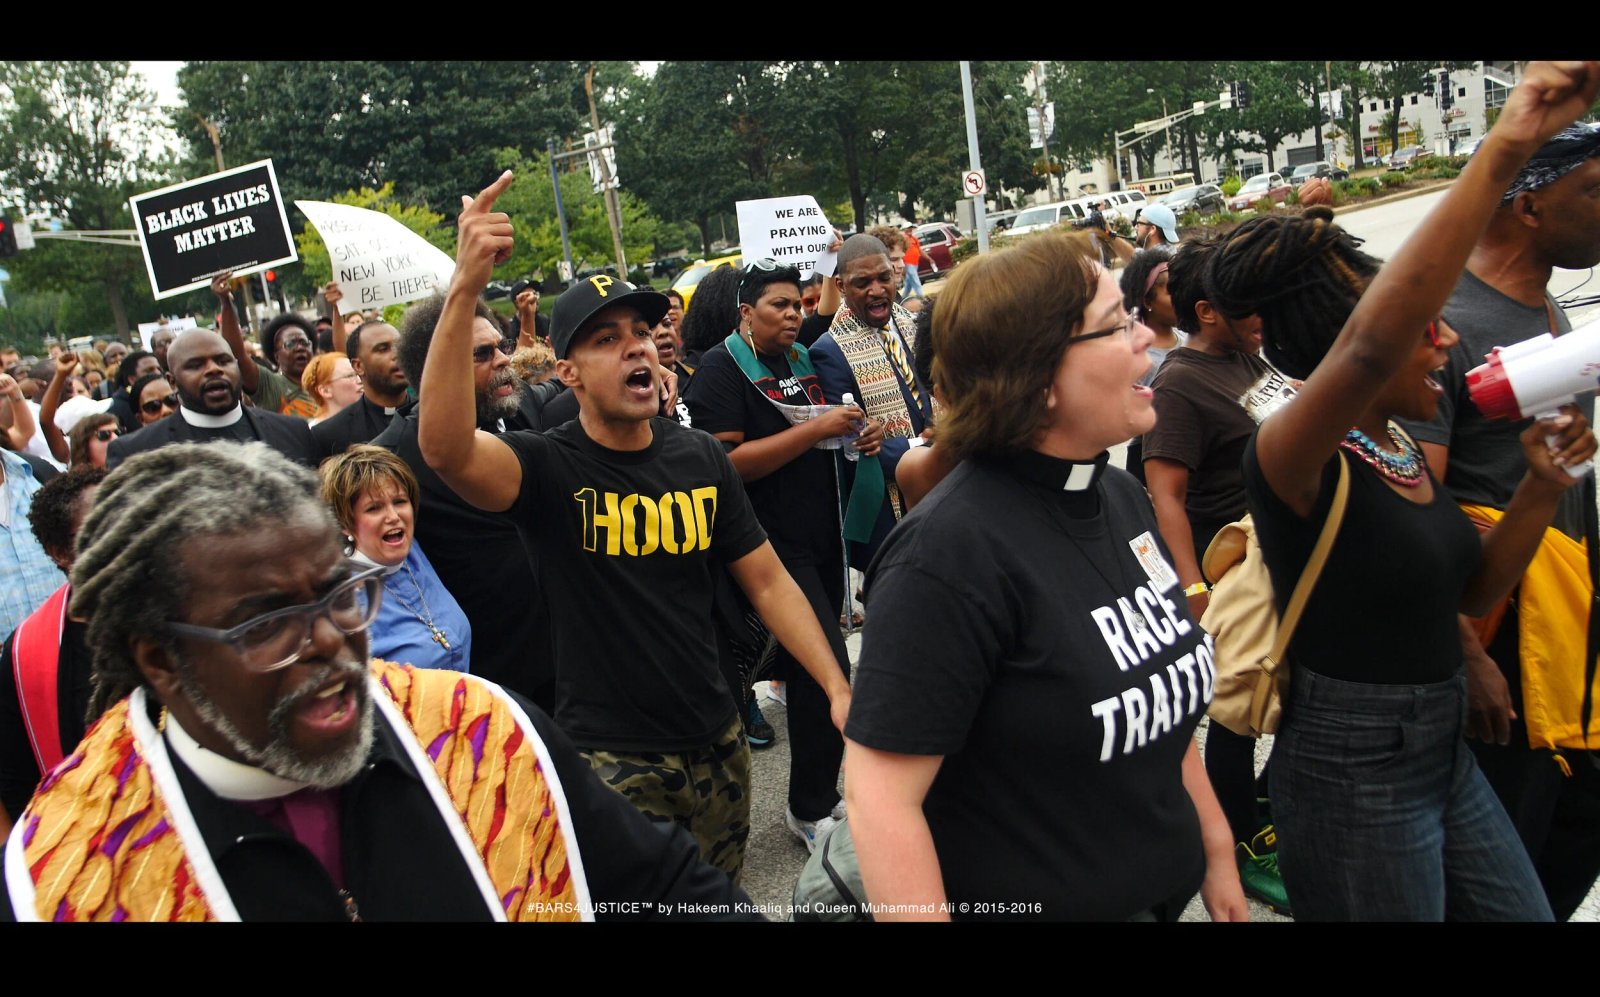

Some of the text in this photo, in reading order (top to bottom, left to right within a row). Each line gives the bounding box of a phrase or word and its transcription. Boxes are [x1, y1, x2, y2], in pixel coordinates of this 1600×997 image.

[145, 184, 270, 234] BLACK LIVES
[775, 207, 819, 219] WE ARE
[173, 215, 256, 254] MATTER
[770, 225, 827, 239] PRAYING
[771, 243, 828, 257] WITH OUR
[340, 262, 376, 283] NEW
[361, 285, 384, 304] BE
[589, 274, 614, 298] P
[573, 486, 718, 557] 1HOOD
[1090, 580, 1192, 671] RACE
[1091, 633, 1216, 762] TRAITO
